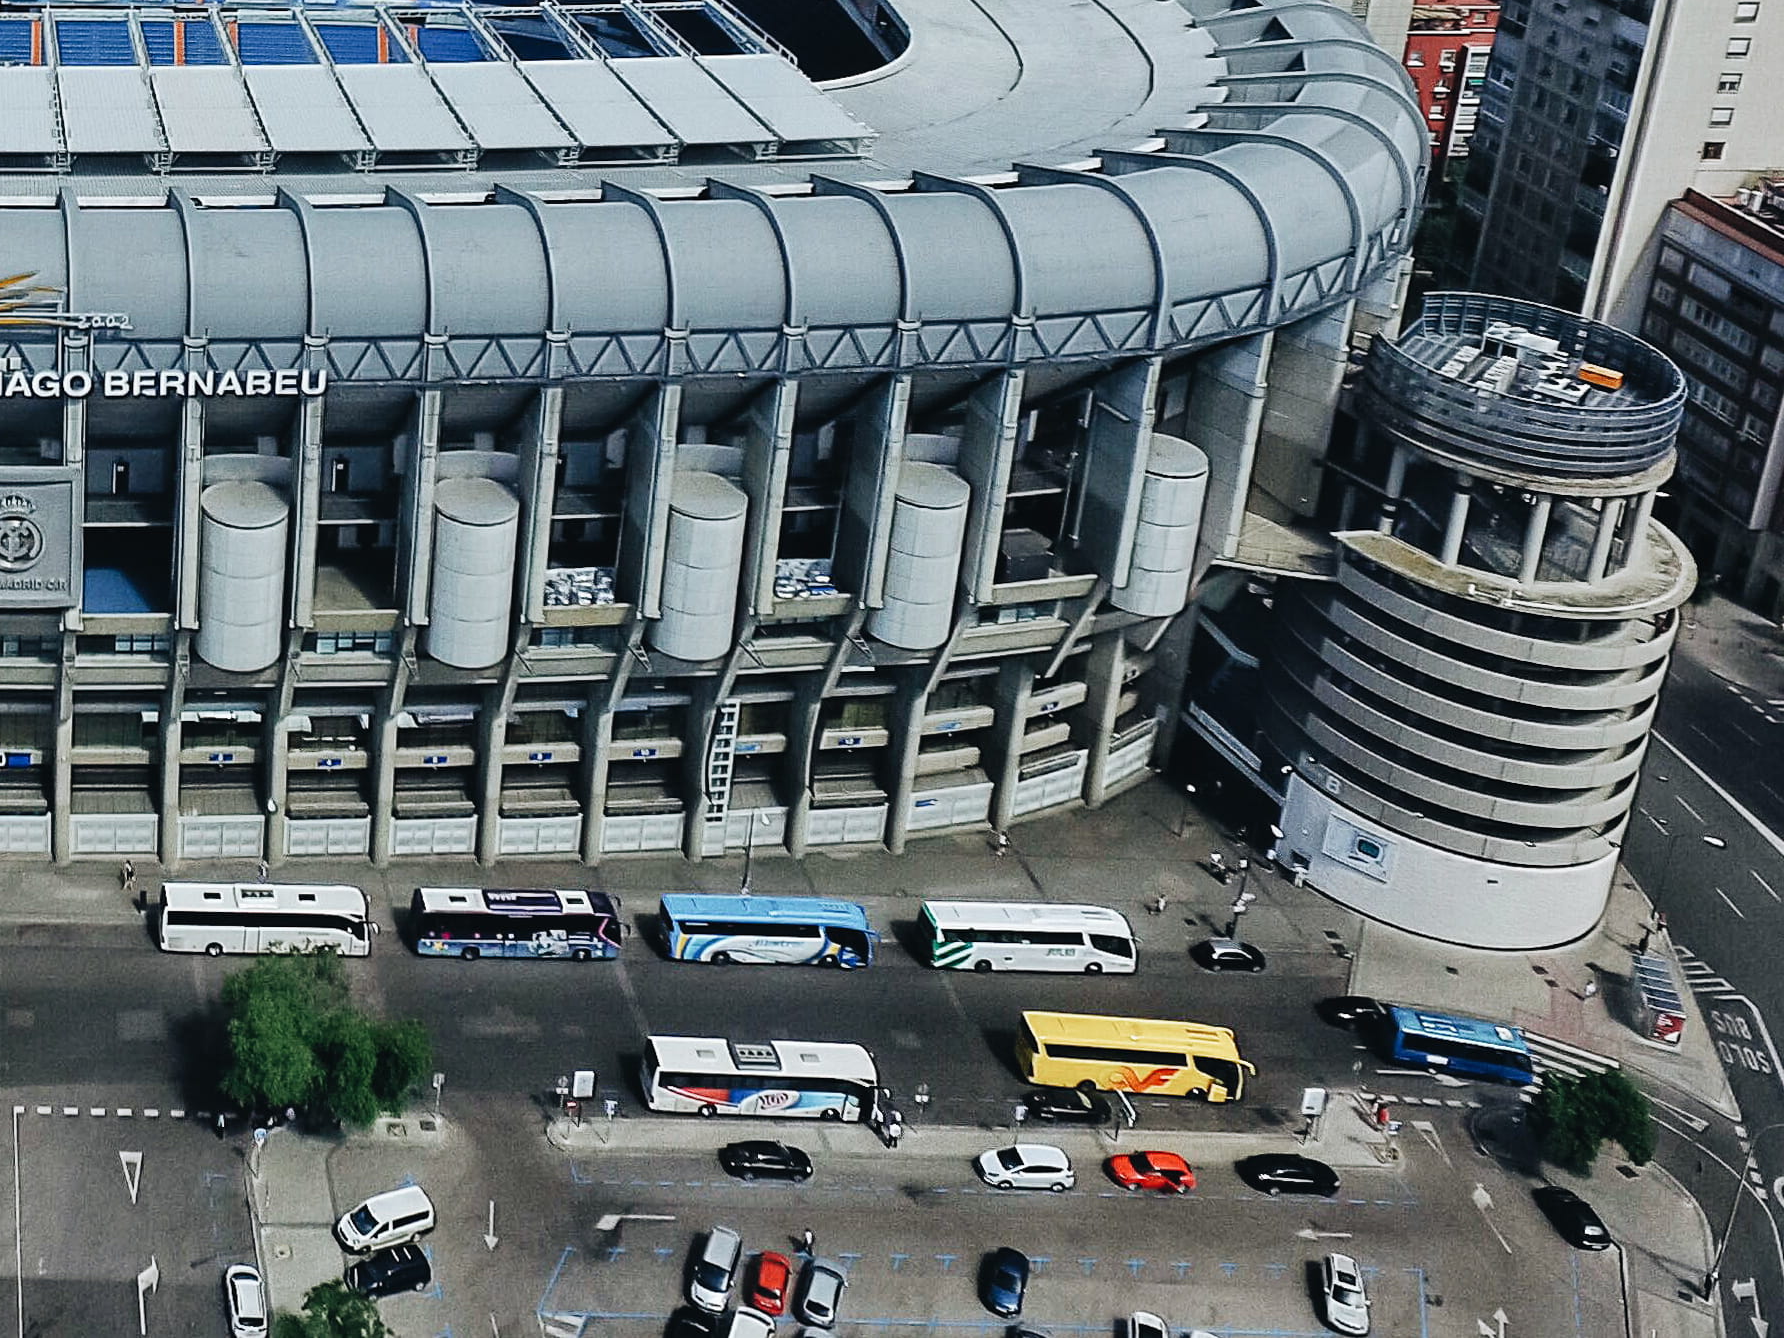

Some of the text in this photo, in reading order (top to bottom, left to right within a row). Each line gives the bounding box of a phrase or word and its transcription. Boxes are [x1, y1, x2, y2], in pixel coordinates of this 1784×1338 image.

[77, 314, 134, 329] 2002
[104, 368, 327, 398] BERNABEU
[1710, 1010, 1752, 1041] BUS
[1718, 1040, 1772, 1074] SOLO
